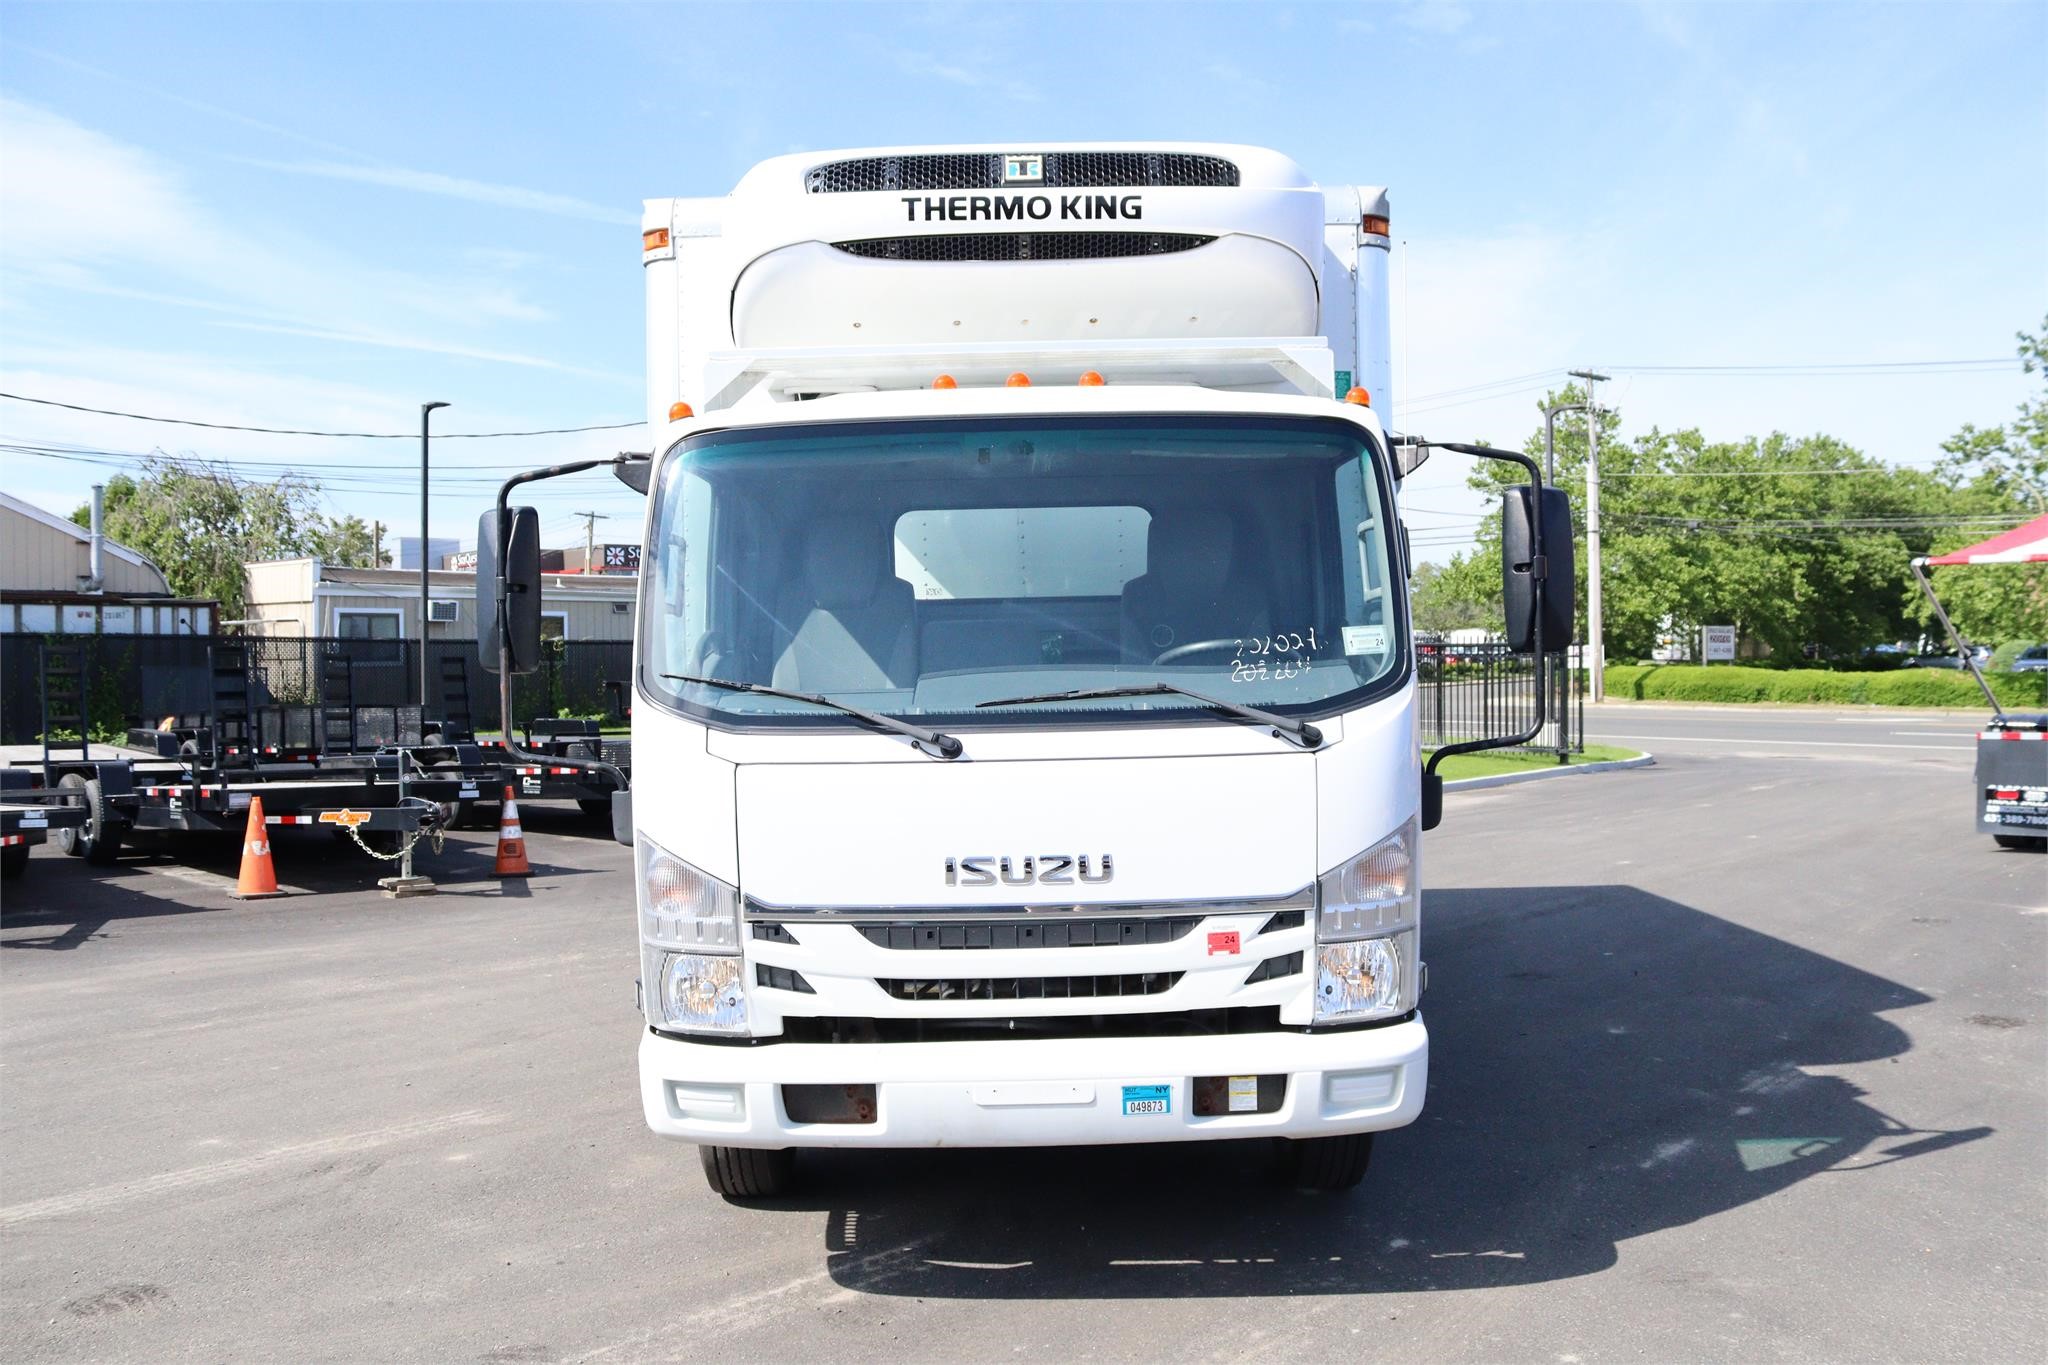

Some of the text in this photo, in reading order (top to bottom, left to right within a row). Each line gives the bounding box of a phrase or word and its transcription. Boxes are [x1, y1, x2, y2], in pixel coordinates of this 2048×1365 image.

[901, 195, 1142, 221] THERMO KING
[945, 853, 1114, 887] ISUZU
[1224, 935, 1235, 944] 24
[1155, 1085, 1169, 1094] NY
[1130, 1101, 1163, 1113] 049873
